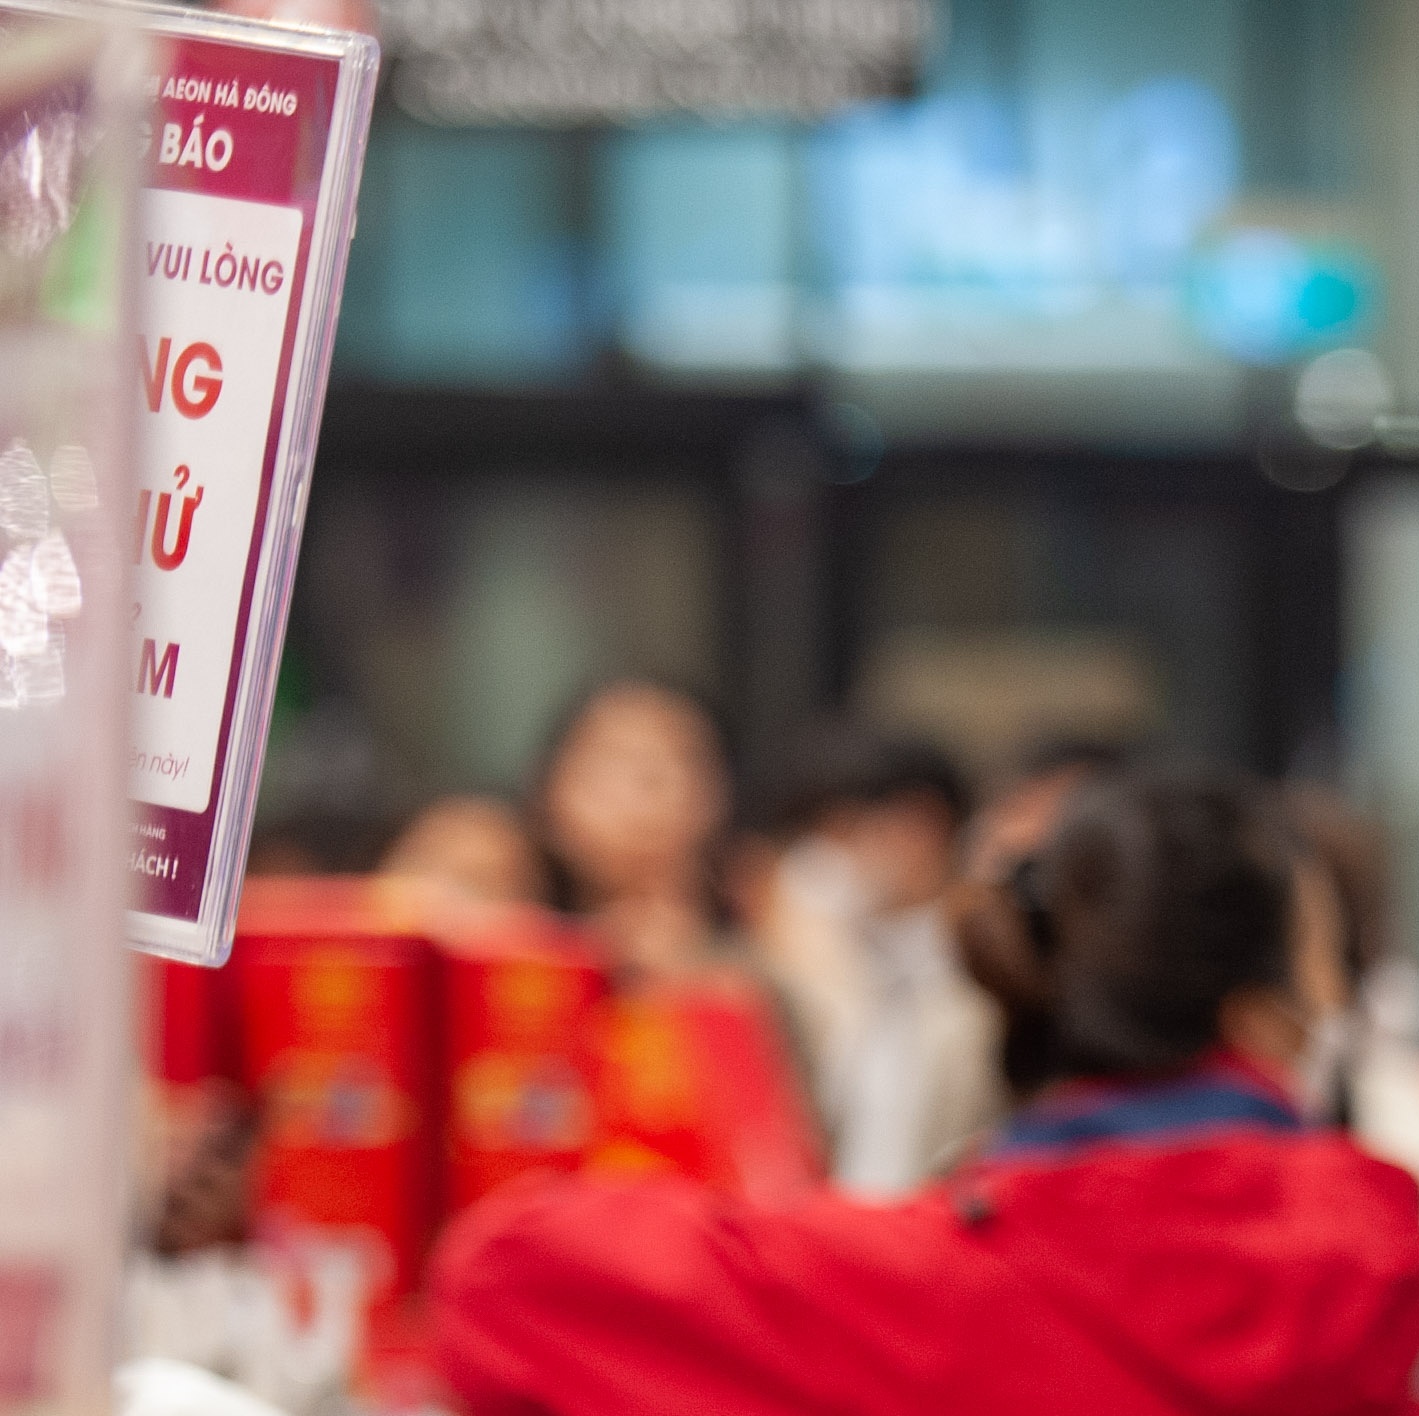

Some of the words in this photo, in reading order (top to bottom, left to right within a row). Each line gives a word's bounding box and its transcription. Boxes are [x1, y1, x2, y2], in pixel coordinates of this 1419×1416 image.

[162, 77, 212, 104] AEON
[214, 79, 239, 108] HÀ
[243, 83, 298, 116] ĐÔNG
[159, 113, 234, 172] BÁO
[146, 240, 192, 281] VUI
[199, 242, 284, 295] LÒNG
[137, 334, 223, 420] NG
[149, 753, 189, 781] này!
